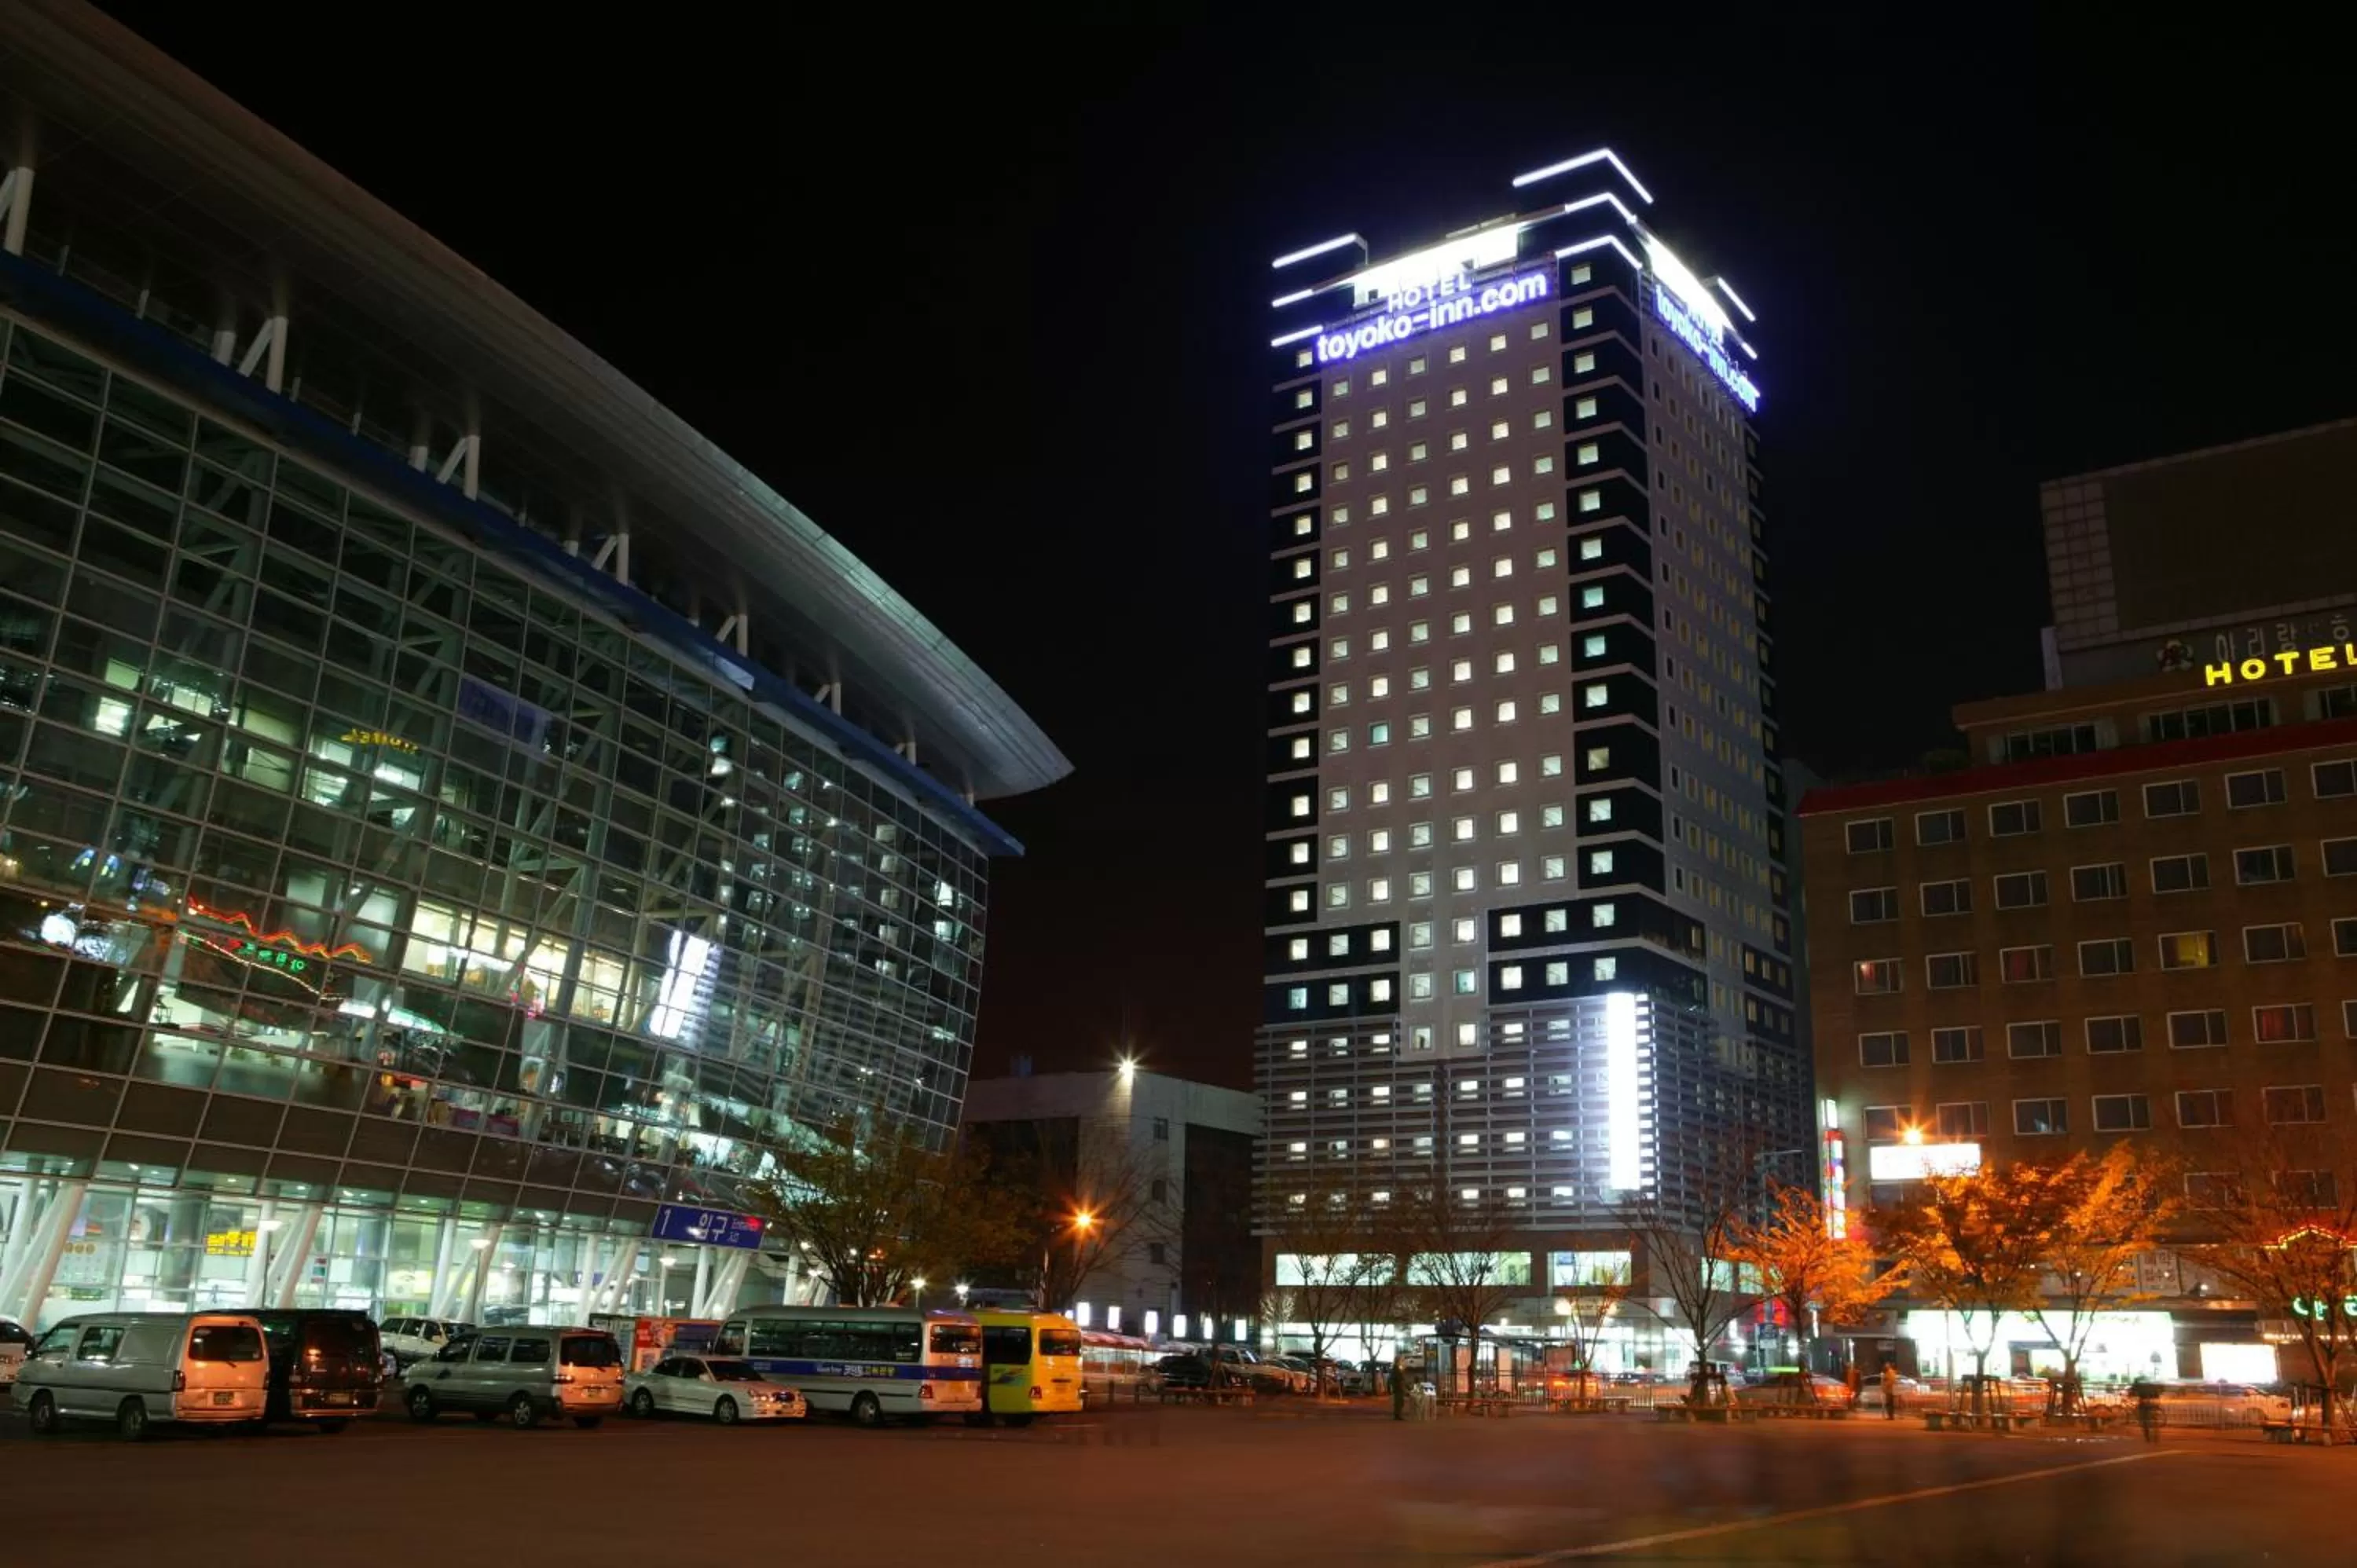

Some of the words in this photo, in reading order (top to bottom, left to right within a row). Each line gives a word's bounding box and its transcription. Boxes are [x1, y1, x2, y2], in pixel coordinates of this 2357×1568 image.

[1387, 272, 1473, 313] HOTEL
[1316, 273, 1548, 361] toyoko-inn.com
[2205, 643, 2357, 686] HOTEL
[661, 1208, 672, 1236] 1
[695, 1212, 729, 1241] 입구
